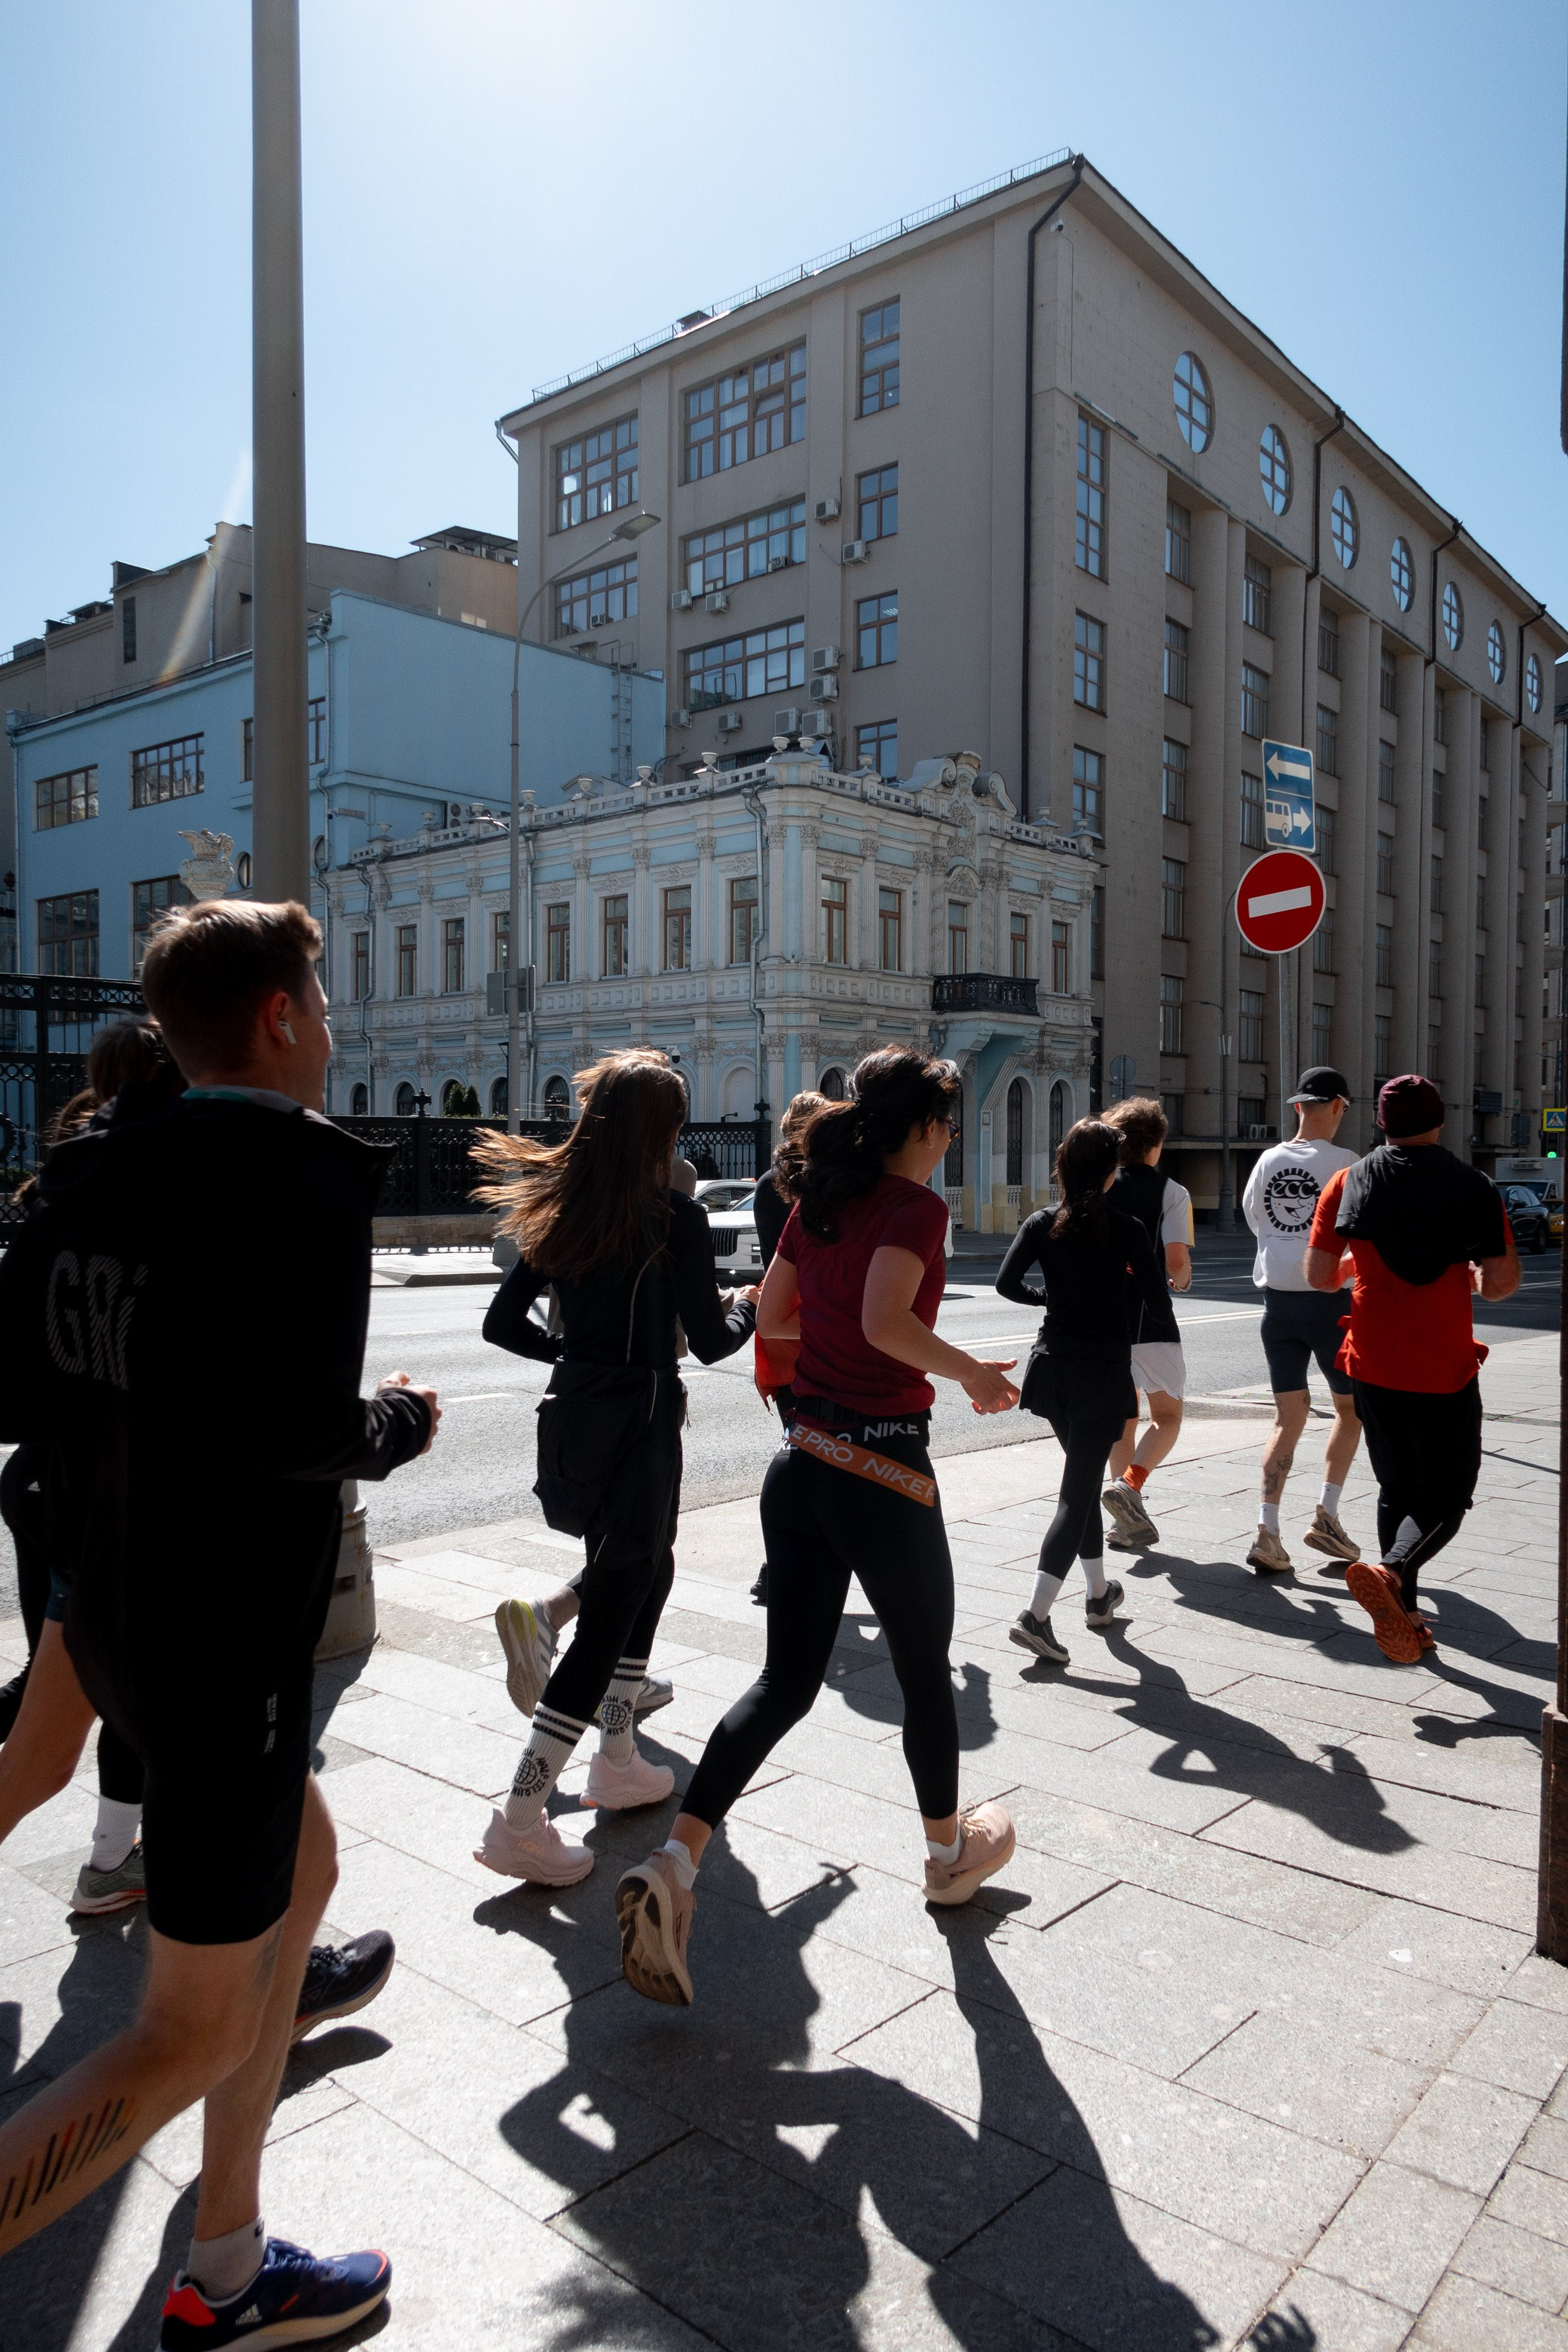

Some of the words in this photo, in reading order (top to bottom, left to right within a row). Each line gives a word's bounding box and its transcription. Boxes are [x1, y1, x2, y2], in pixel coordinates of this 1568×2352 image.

[863, 1422, 920, 1441] NIKE
[792, 1424, 853, 1462] EPRO
[862, 1457, 934, 1499] NIKE
